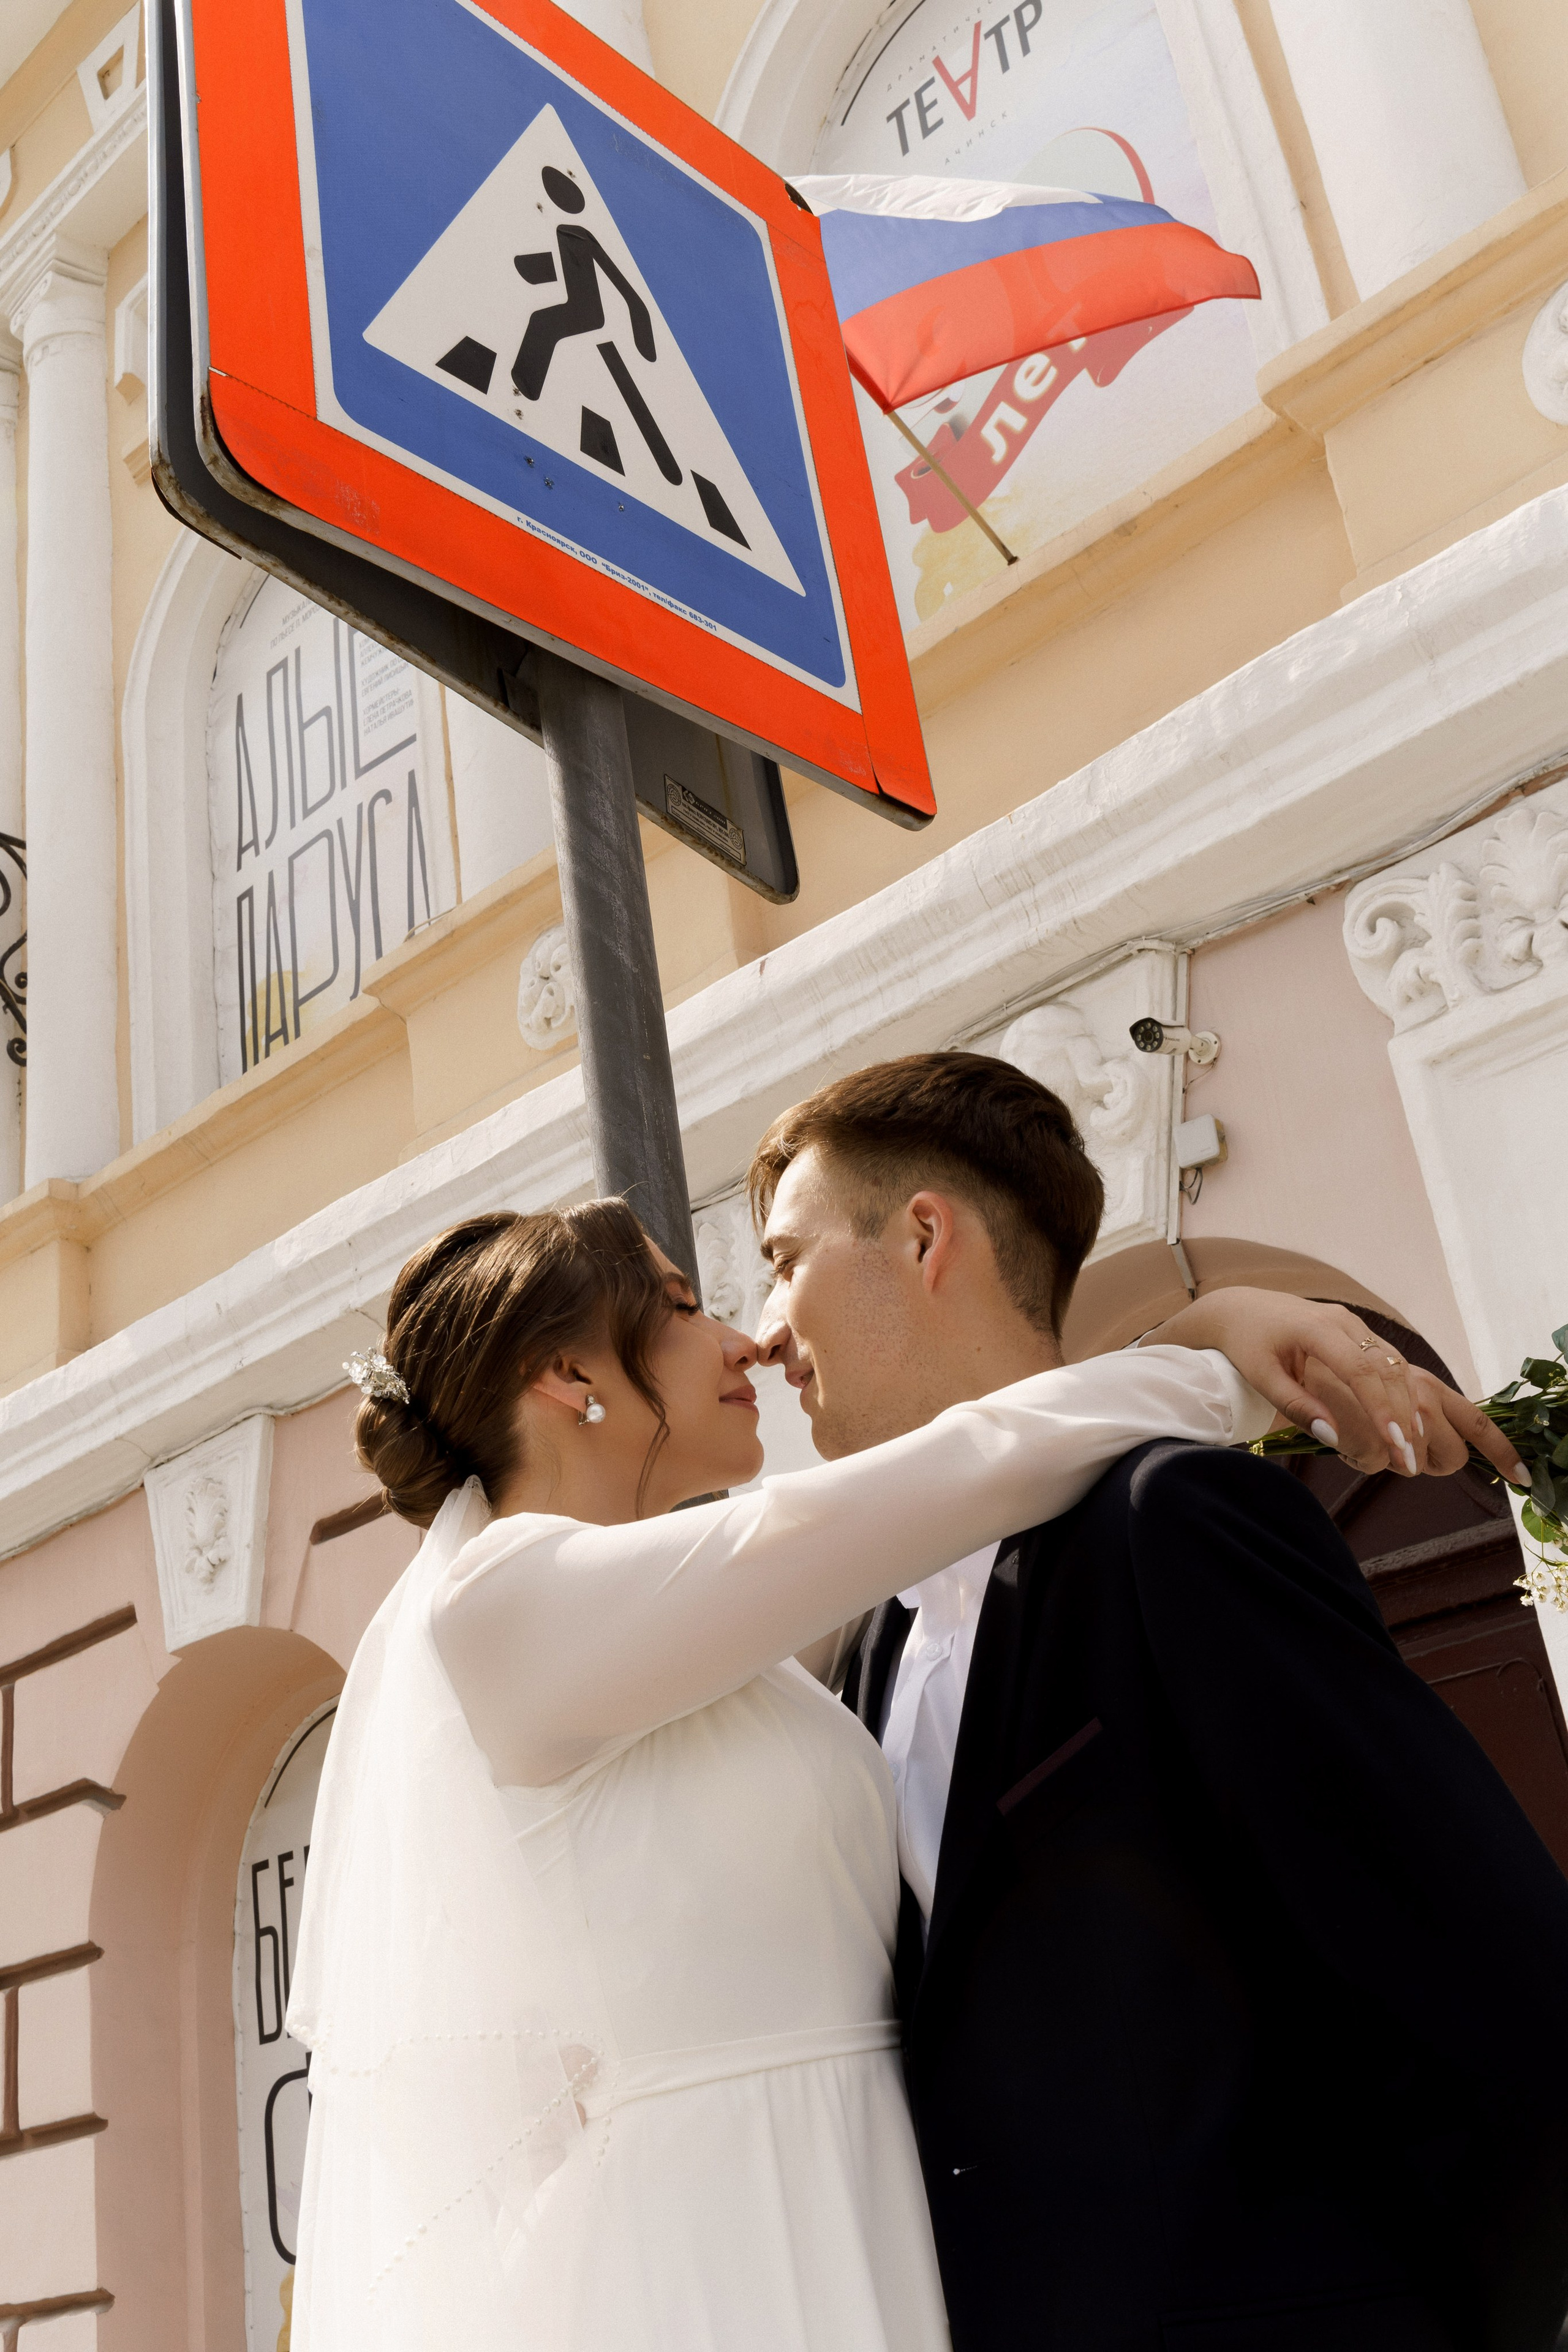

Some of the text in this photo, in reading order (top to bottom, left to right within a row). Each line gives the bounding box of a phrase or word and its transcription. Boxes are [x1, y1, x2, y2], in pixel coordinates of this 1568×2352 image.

[886, 0, 1042, 157] ТЕАТР
[944, 110, 1008, 165] АЧИНСК
[526, 519, 578, 555] Красноярск,
[579, 550, 598, 565] ООО
[652, 592, 687, 616] тел/факс
[689, 611, 717, 631] 683-301
[236, 769, 431, 1075] ПАРУСА
